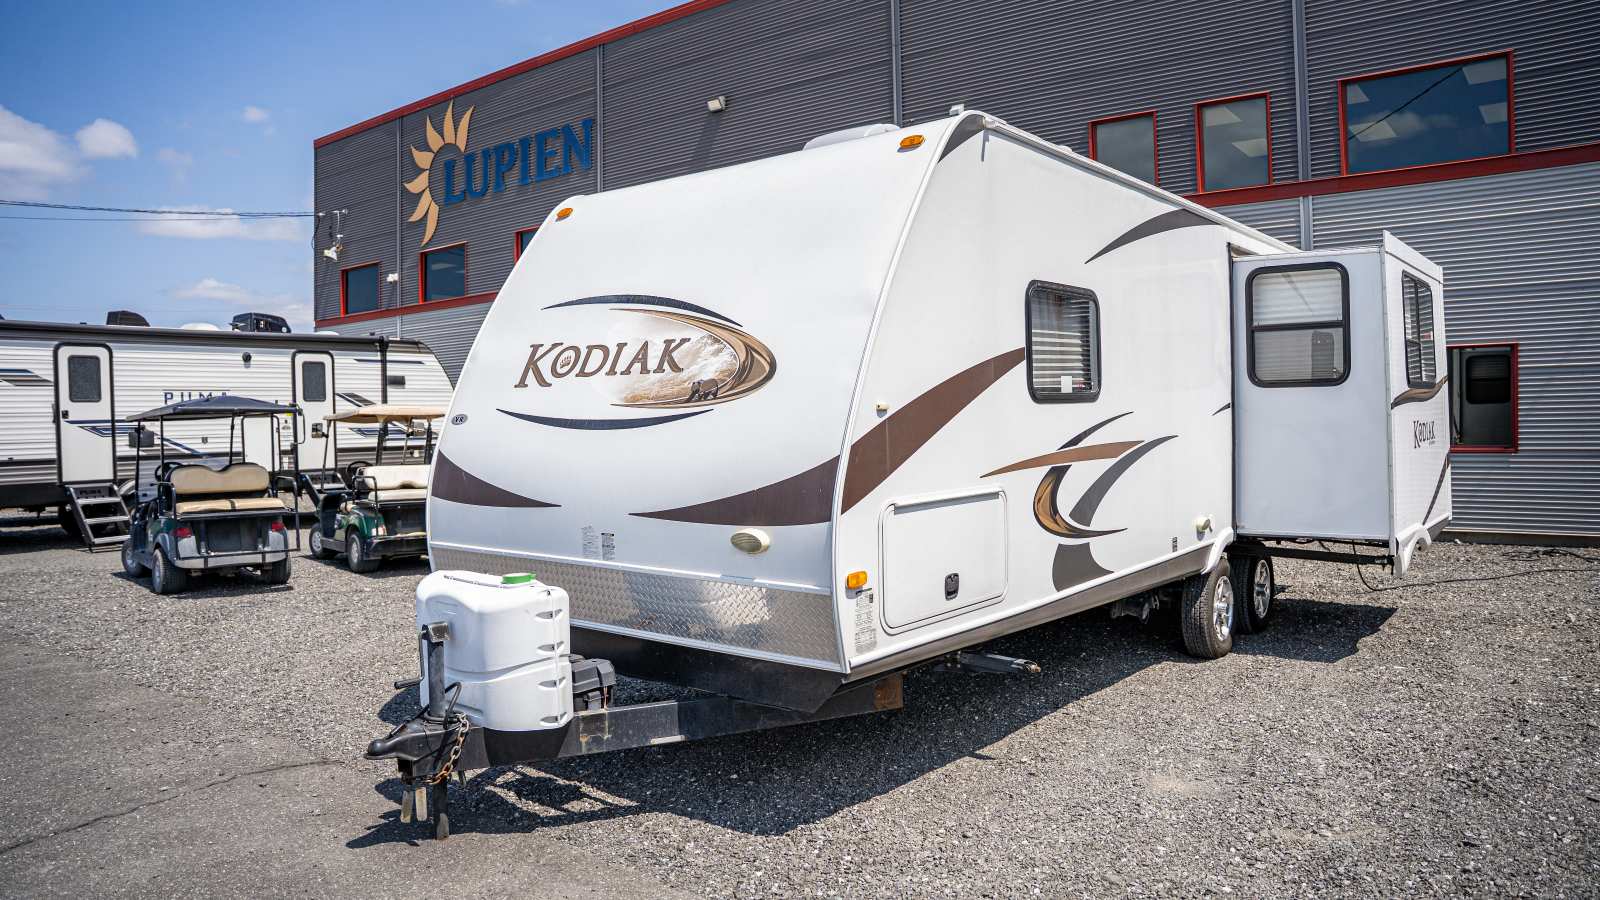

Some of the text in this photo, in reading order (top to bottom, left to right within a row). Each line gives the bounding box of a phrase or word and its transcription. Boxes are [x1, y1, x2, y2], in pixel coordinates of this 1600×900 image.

[443, 118, 593, 208] LUPIEN
[513, 337, 692, 389] KODIAK
[1413, 420, 1436, 449] KODIAK
